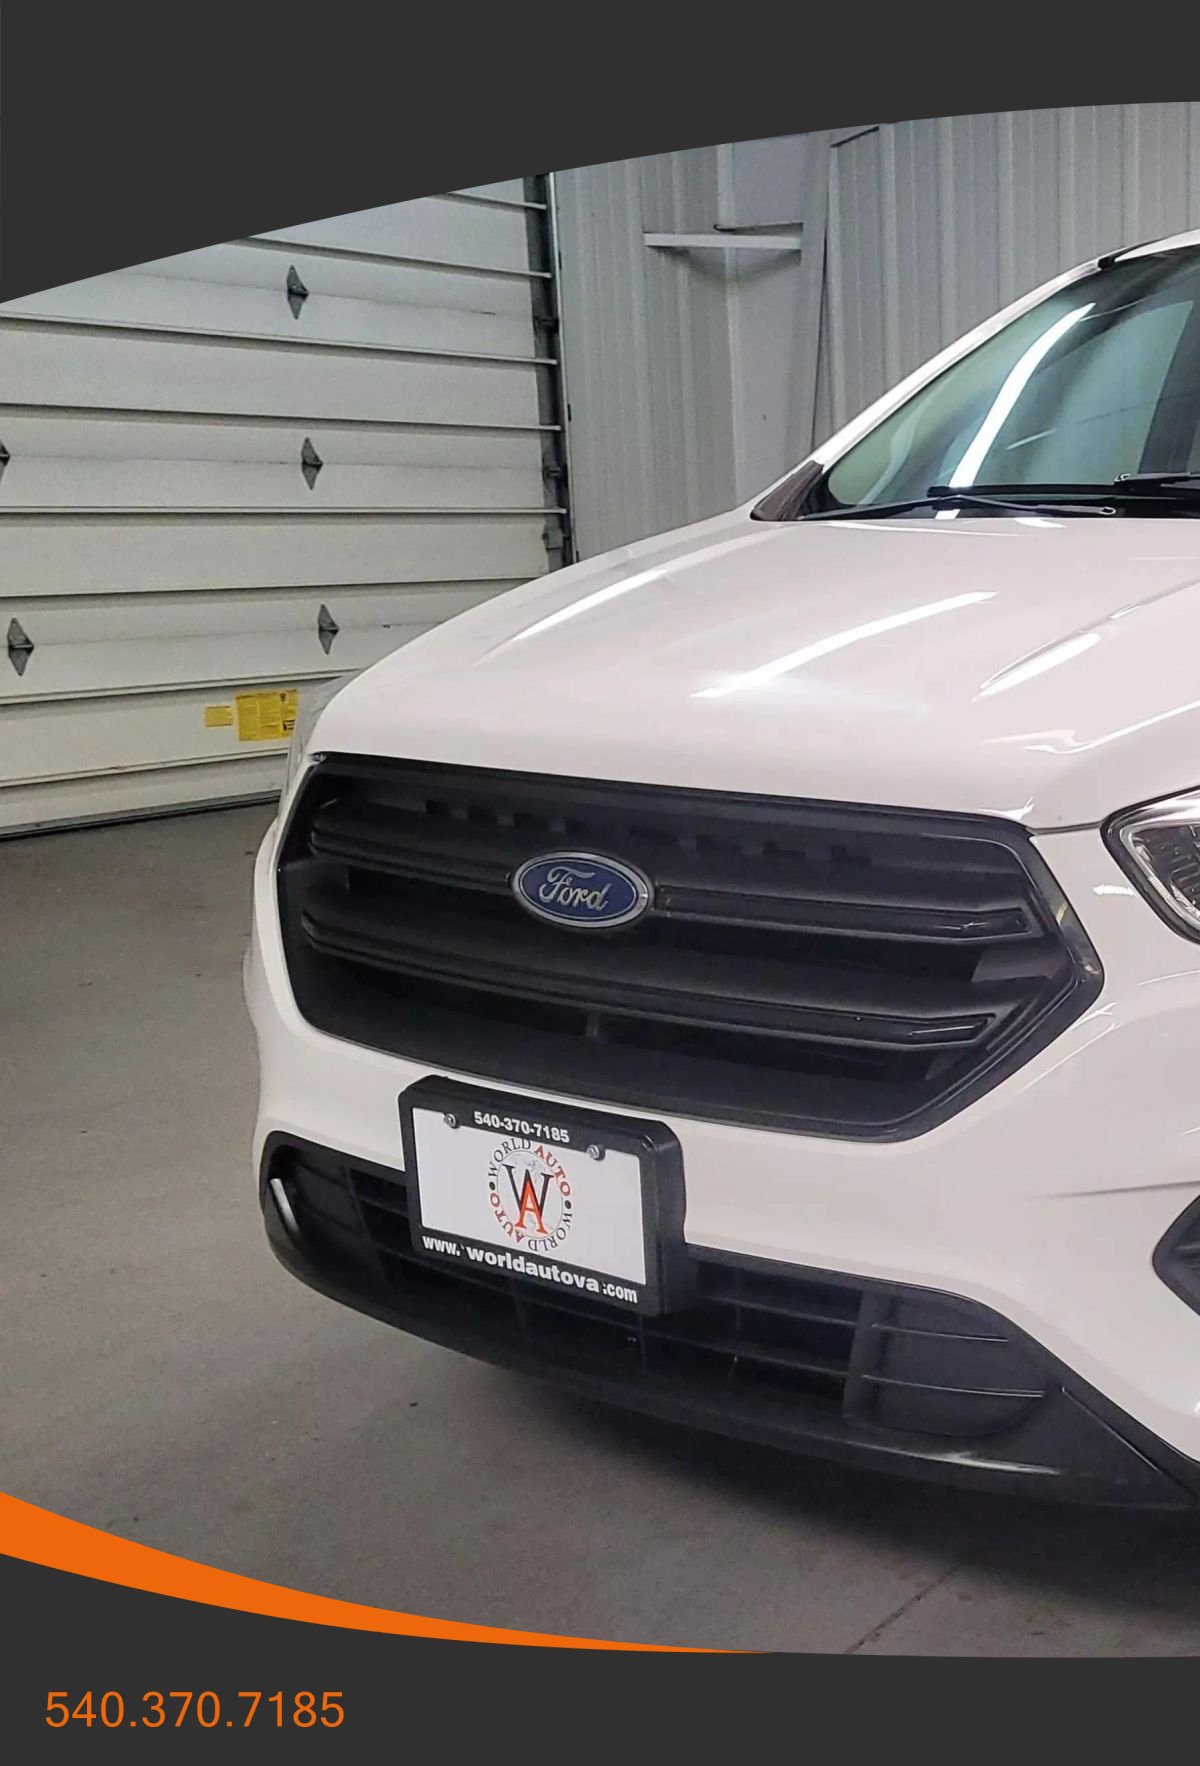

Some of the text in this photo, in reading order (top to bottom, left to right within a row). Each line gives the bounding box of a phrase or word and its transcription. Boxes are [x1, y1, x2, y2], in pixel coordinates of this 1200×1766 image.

[538, 866, 613, 911] Ford
[473, 1111, 570, 1143] 540-370-7185
[488, 1138, 571, 1197] WORLD AUTO
[489, 1192, 573, 1251] WORLD AUTO
